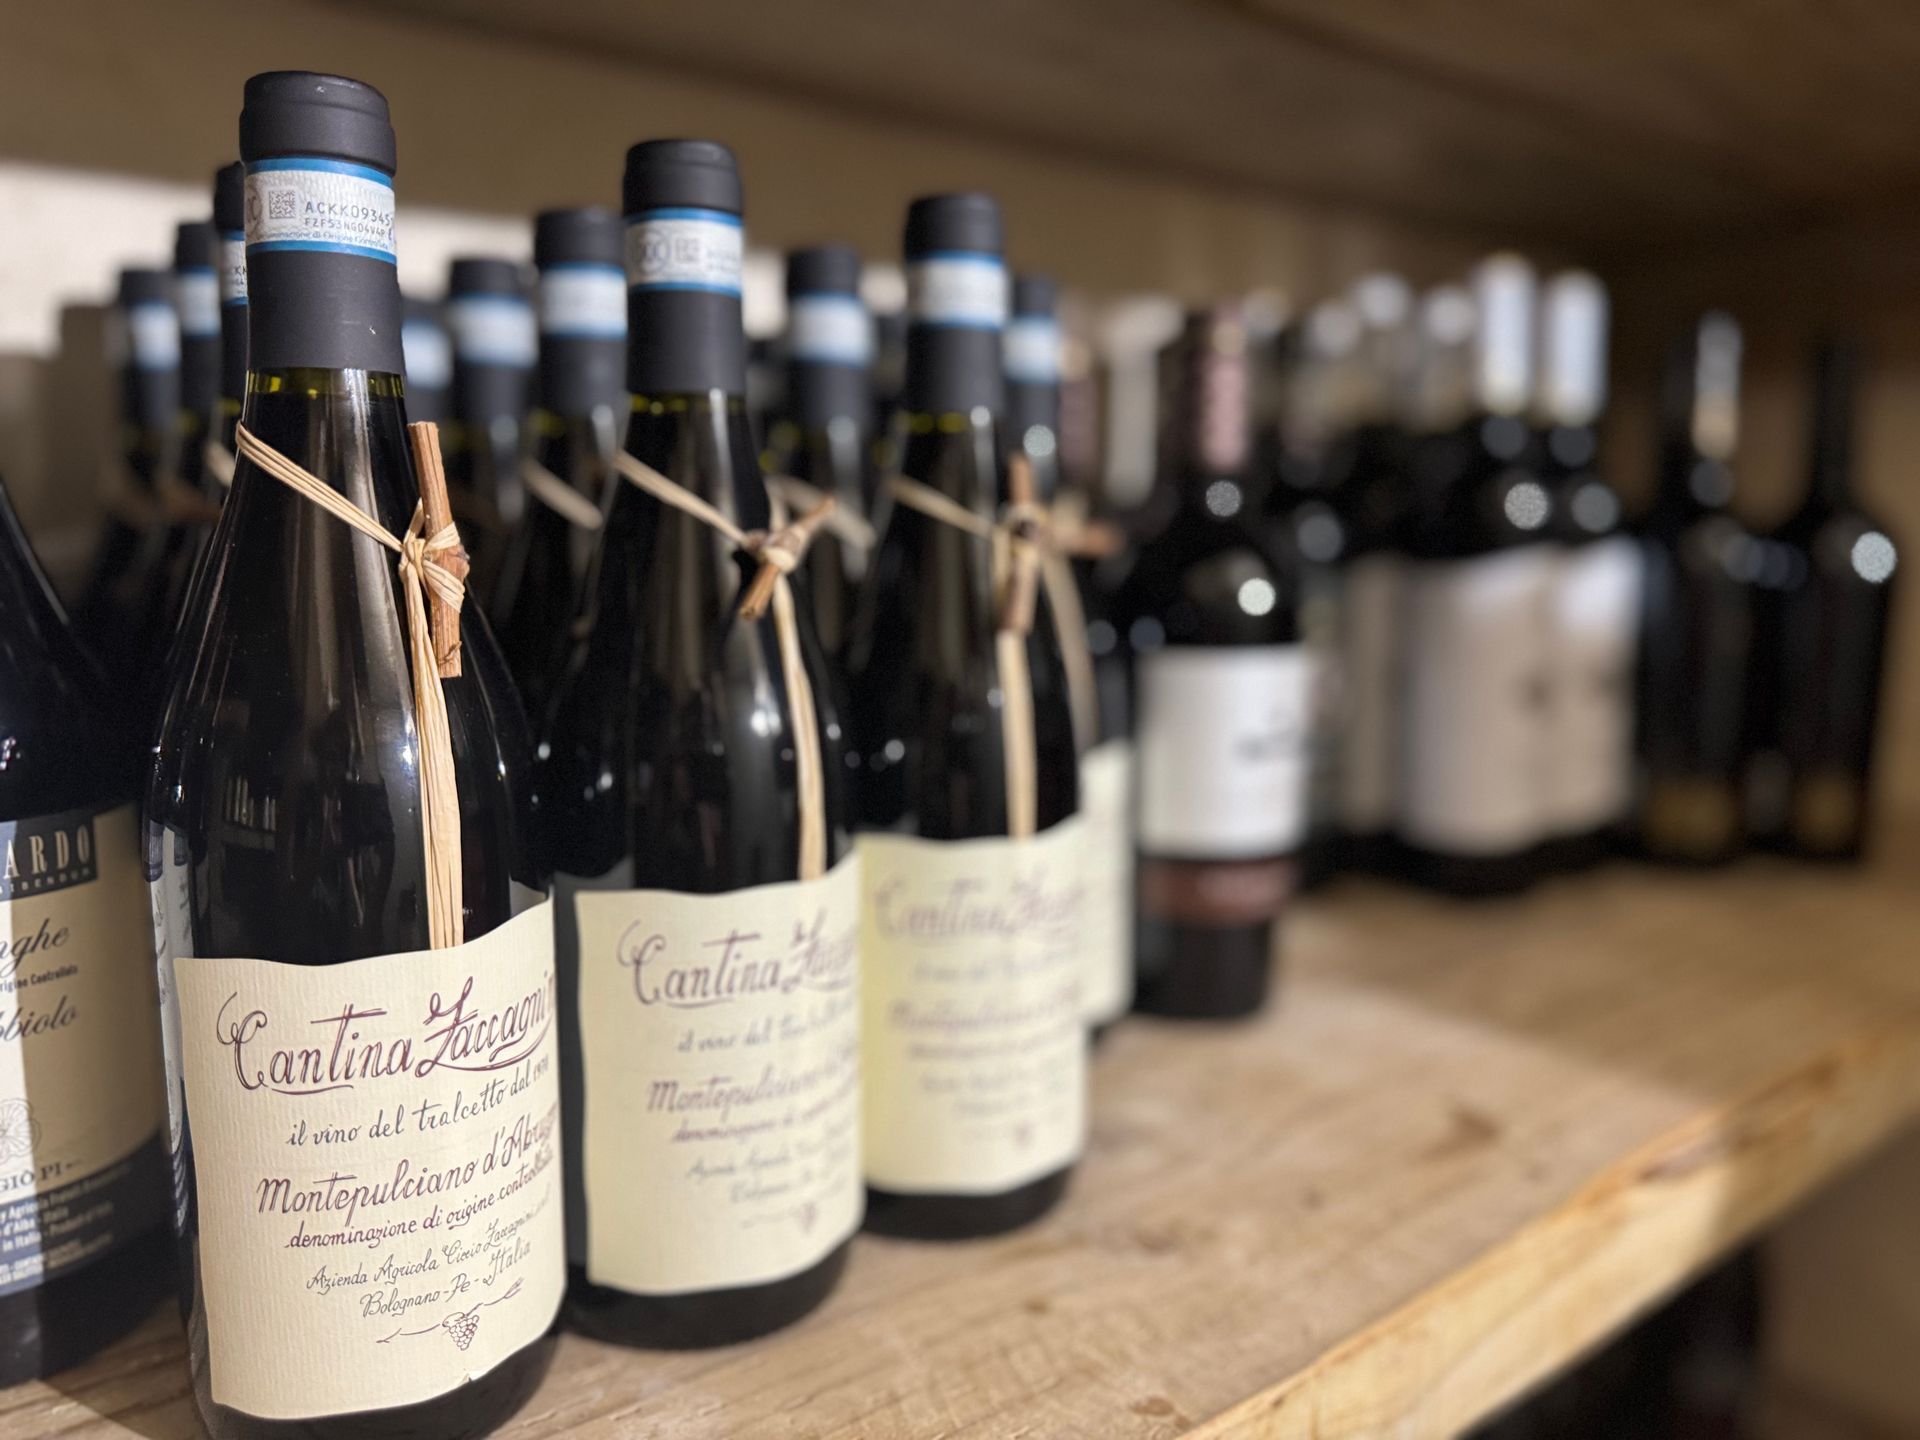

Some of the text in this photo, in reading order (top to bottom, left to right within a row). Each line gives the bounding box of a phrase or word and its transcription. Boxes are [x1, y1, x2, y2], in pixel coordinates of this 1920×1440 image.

[305, 201, 393, 227] ACKK09345
[617, 919, 781, 1008] Cantina
[216, 991, 417, 1096] Cantina
[286, 1123, 305, 1146] il
[311, 1124, 361, 1145] vino
[369, 1111, 405, 1138] del
[412, 1078, 505, 1131] tralcetto
[510, 1059, 531, 1096] dal
[256, 1157, 477, 1227] Montepulciano
[285, 1219, 417, 1249] denominazione
[423, 1208, 443, 1231] di
[446, 1191, 495, 1230] origine
[306, 1264, 368, 1296] Azienda
[373, 1248, 440, 1286] Agricola
